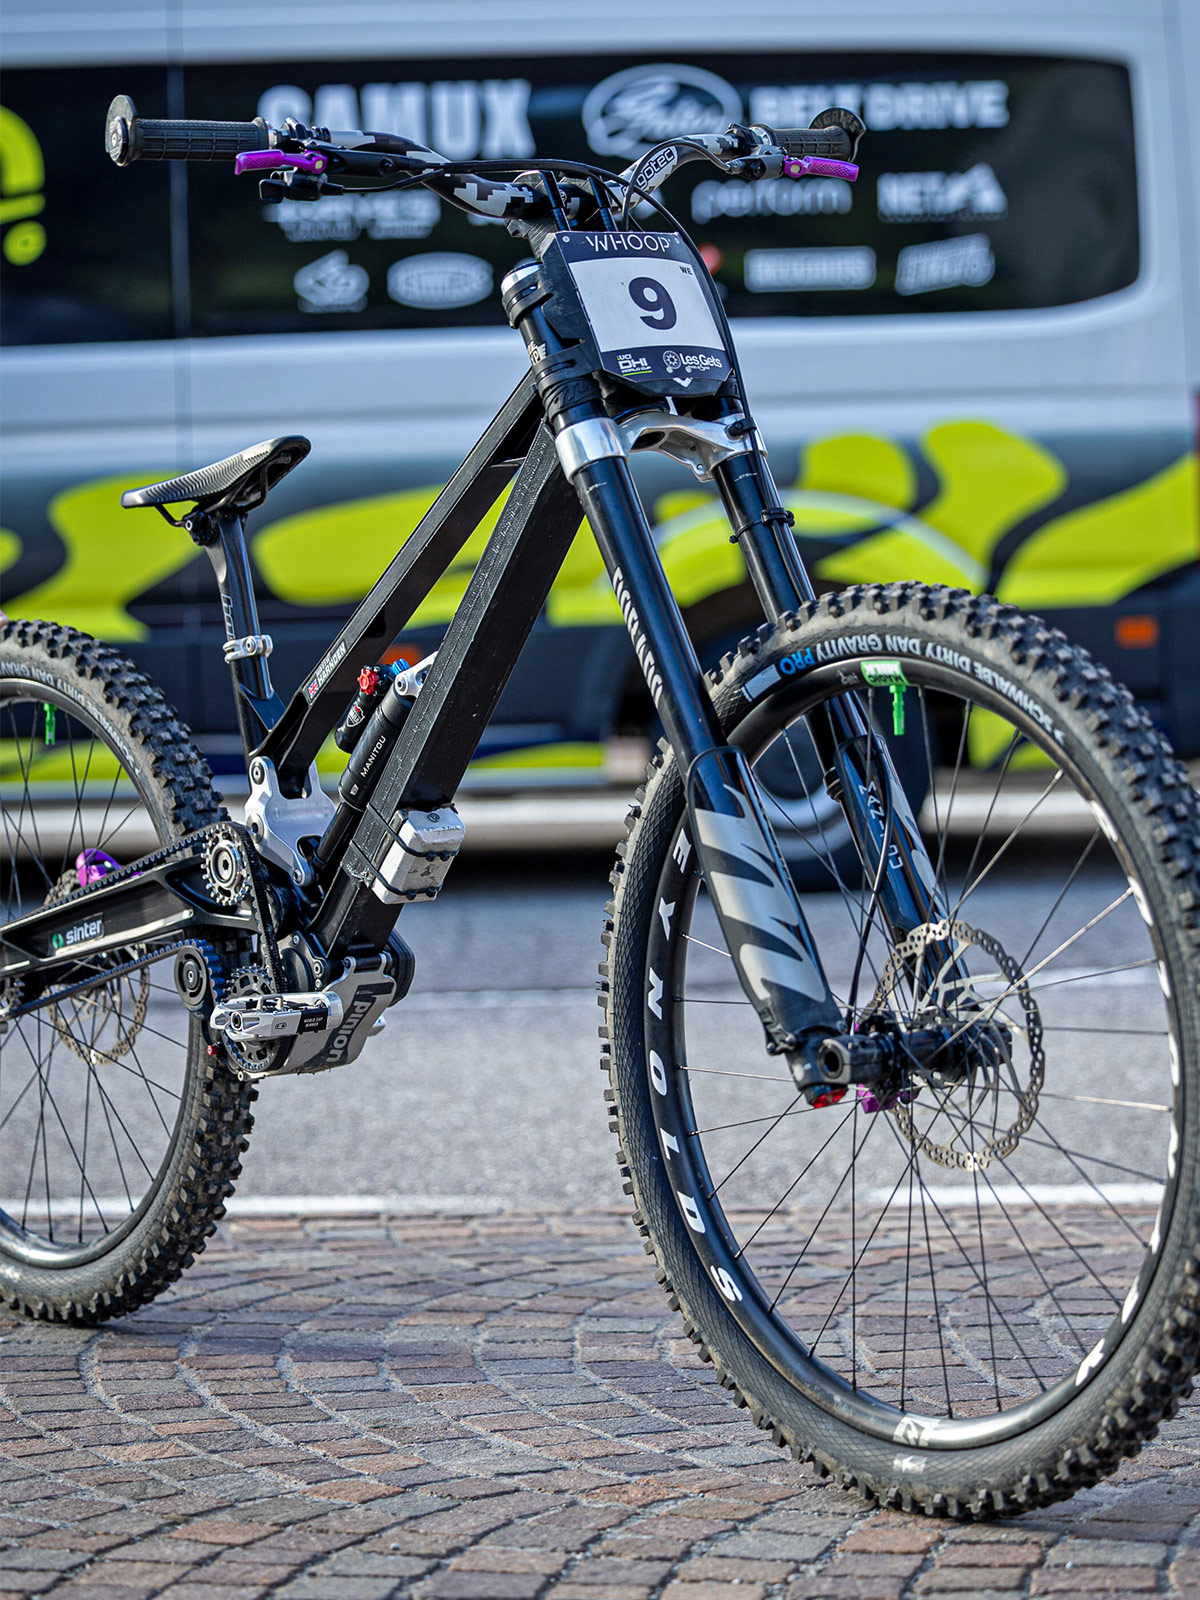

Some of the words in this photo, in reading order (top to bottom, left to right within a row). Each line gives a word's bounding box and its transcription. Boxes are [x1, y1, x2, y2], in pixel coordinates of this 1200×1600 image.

[585, 233, 671, 252] WHOOP
[628, 276, 677, 331] 9
[618, 357, 648, 370] DHI
[619, 353, 632, 361] UCI
[816, 633, 883, 662] GRAVITY
[885, 633, 922, 656] DAN
[925, 642, 971, 674] DIRTY
[779, 646, 816, 675] PRO
[973, 661, 1054, 732] SCHWALBE
[360, 735, 387, 778] MANITOU
[65, 919, 103, 946] sinter
